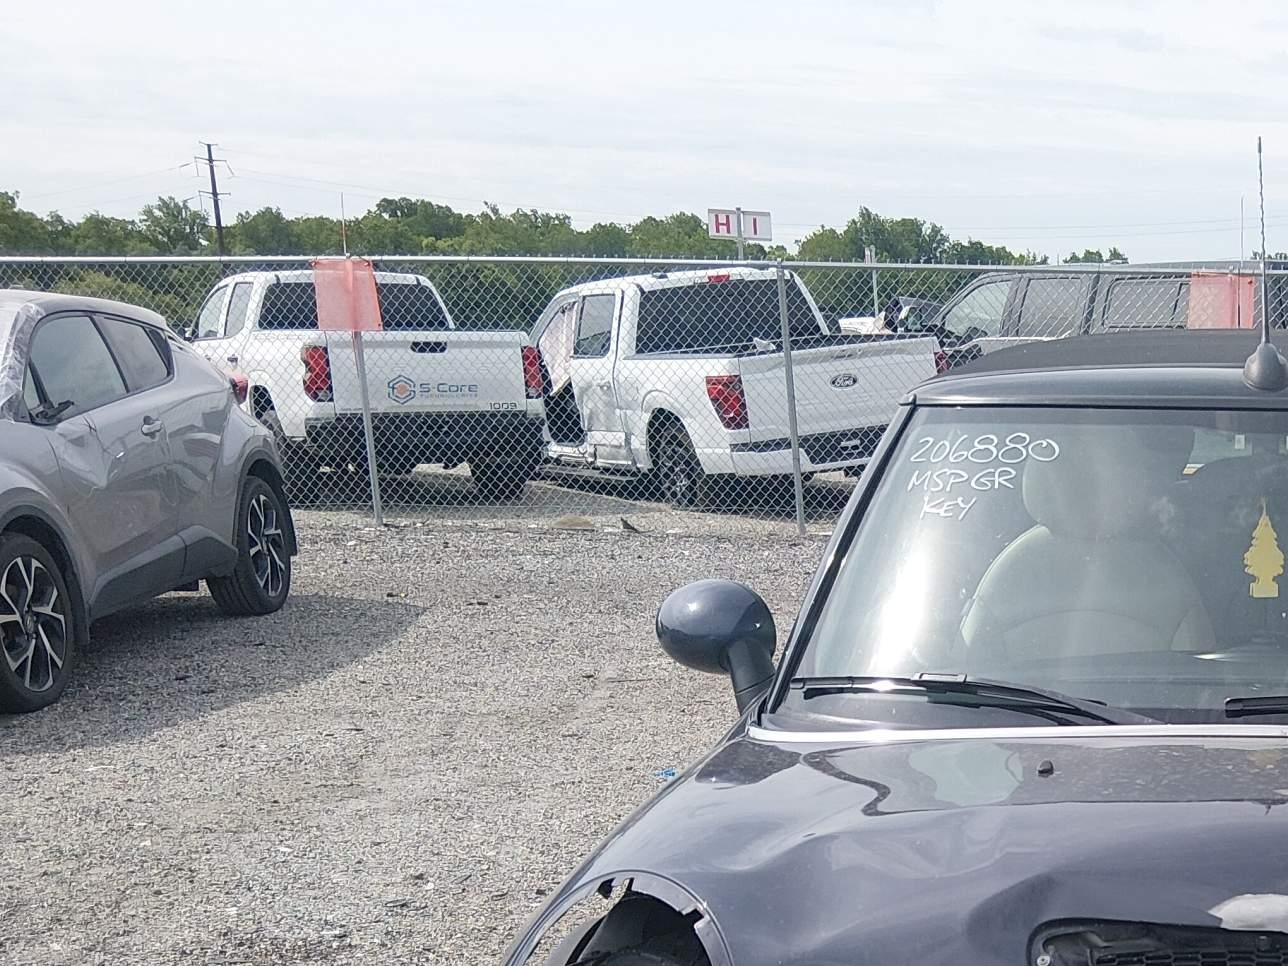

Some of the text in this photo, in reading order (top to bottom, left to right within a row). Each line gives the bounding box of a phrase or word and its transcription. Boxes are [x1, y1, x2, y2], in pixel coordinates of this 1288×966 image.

[715, 214, 731, 234] H
[910, 433, 1059, 463] 206880
[920, 496, 976, 520] KEY
